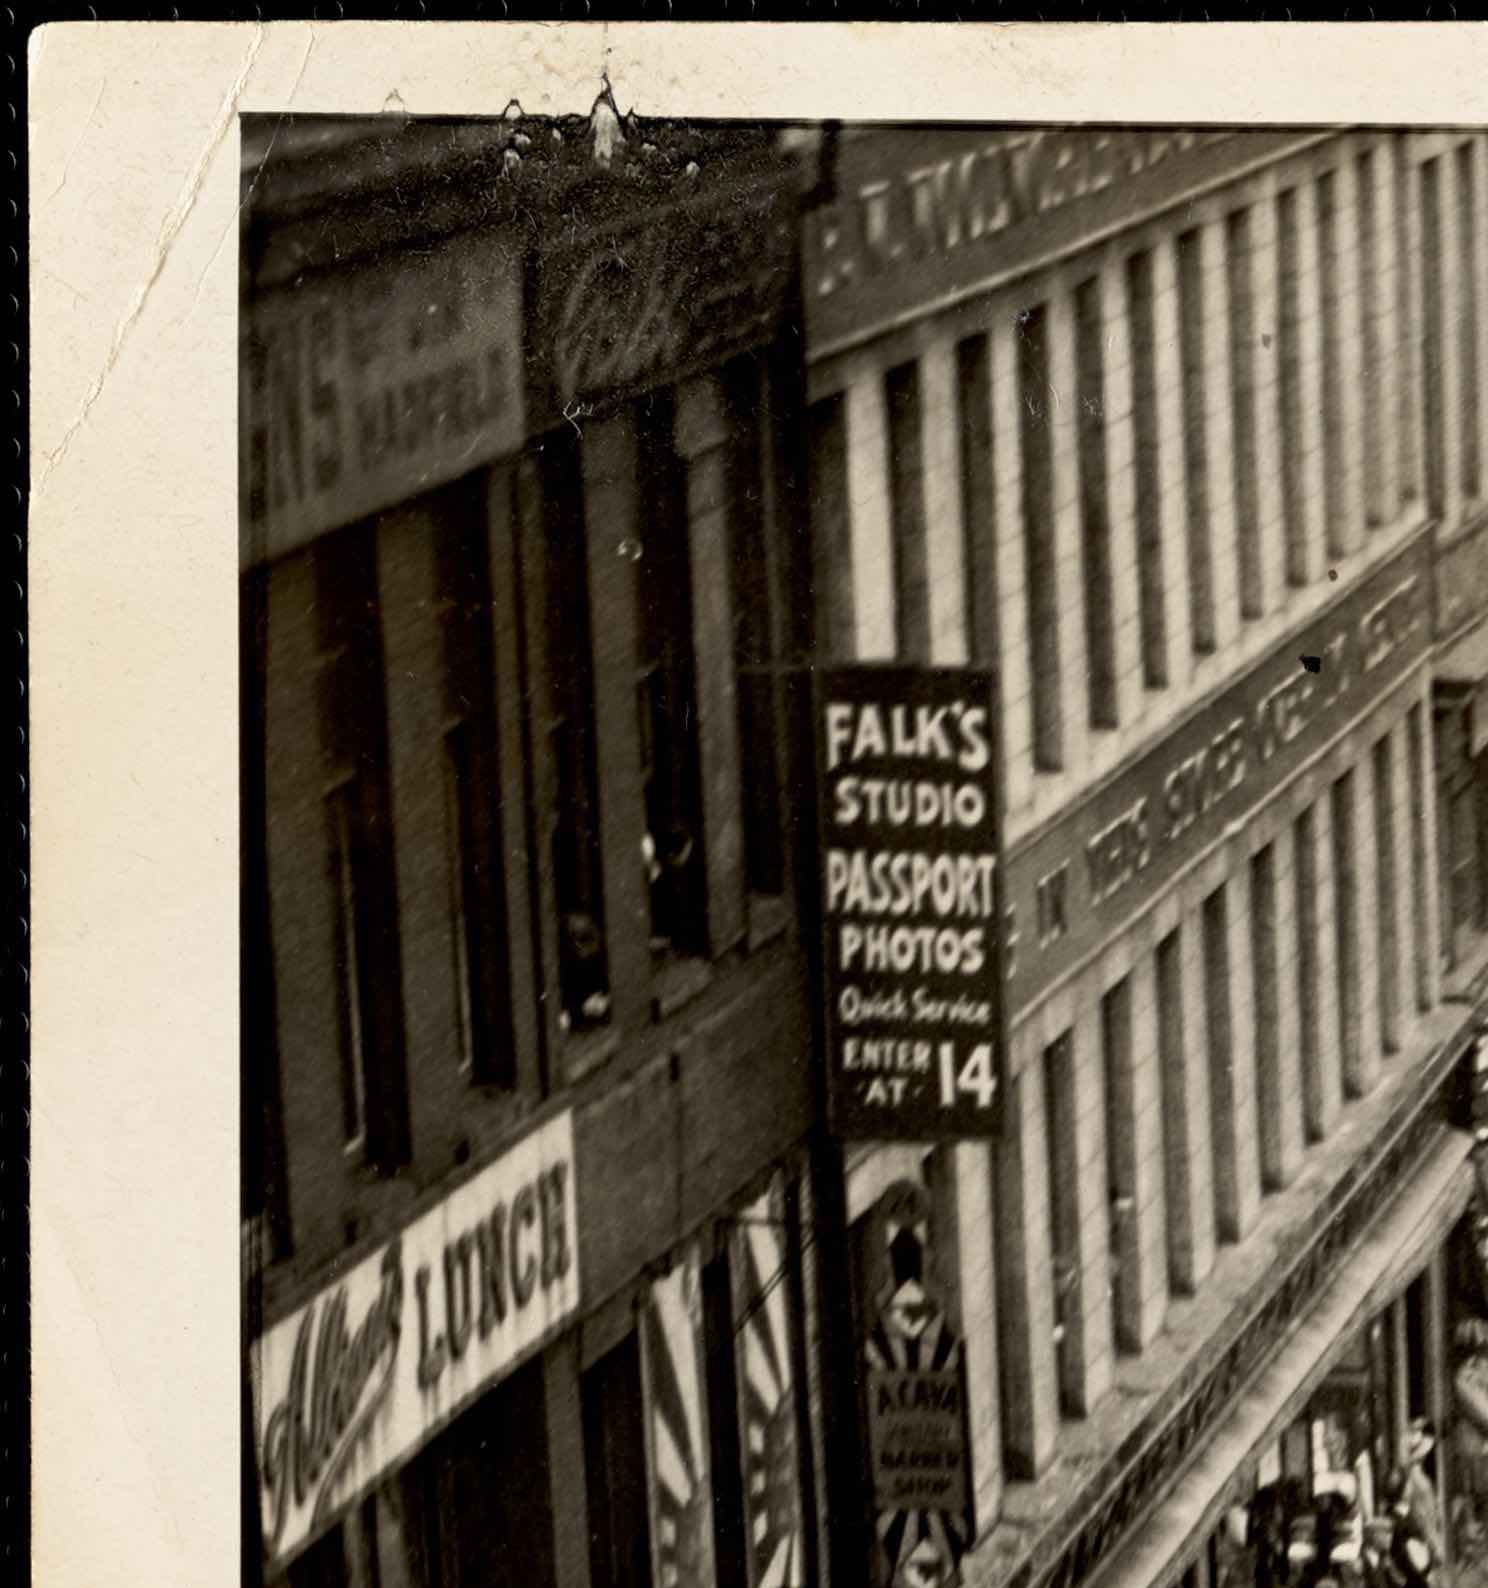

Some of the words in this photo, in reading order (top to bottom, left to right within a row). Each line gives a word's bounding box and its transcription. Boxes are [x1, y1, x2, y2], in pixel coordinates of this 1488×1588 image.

[826, 701, 988, 771] FALK'S
[835, 776, 985, 826] STUDIO
[827, 850, 997, 917] PASSPORT
[839, 925, 985, 974] PHOTOS
[838, 986, 908, 1025] Quick
[911, 988, 990, 1025] Service
[843, 1040, 932, 1073] ENTER
[938, 1042, 997, 1107] 14
[864, 1078, 905, 1105] AT
[414, 1158, 574, 1390] LUNCH
